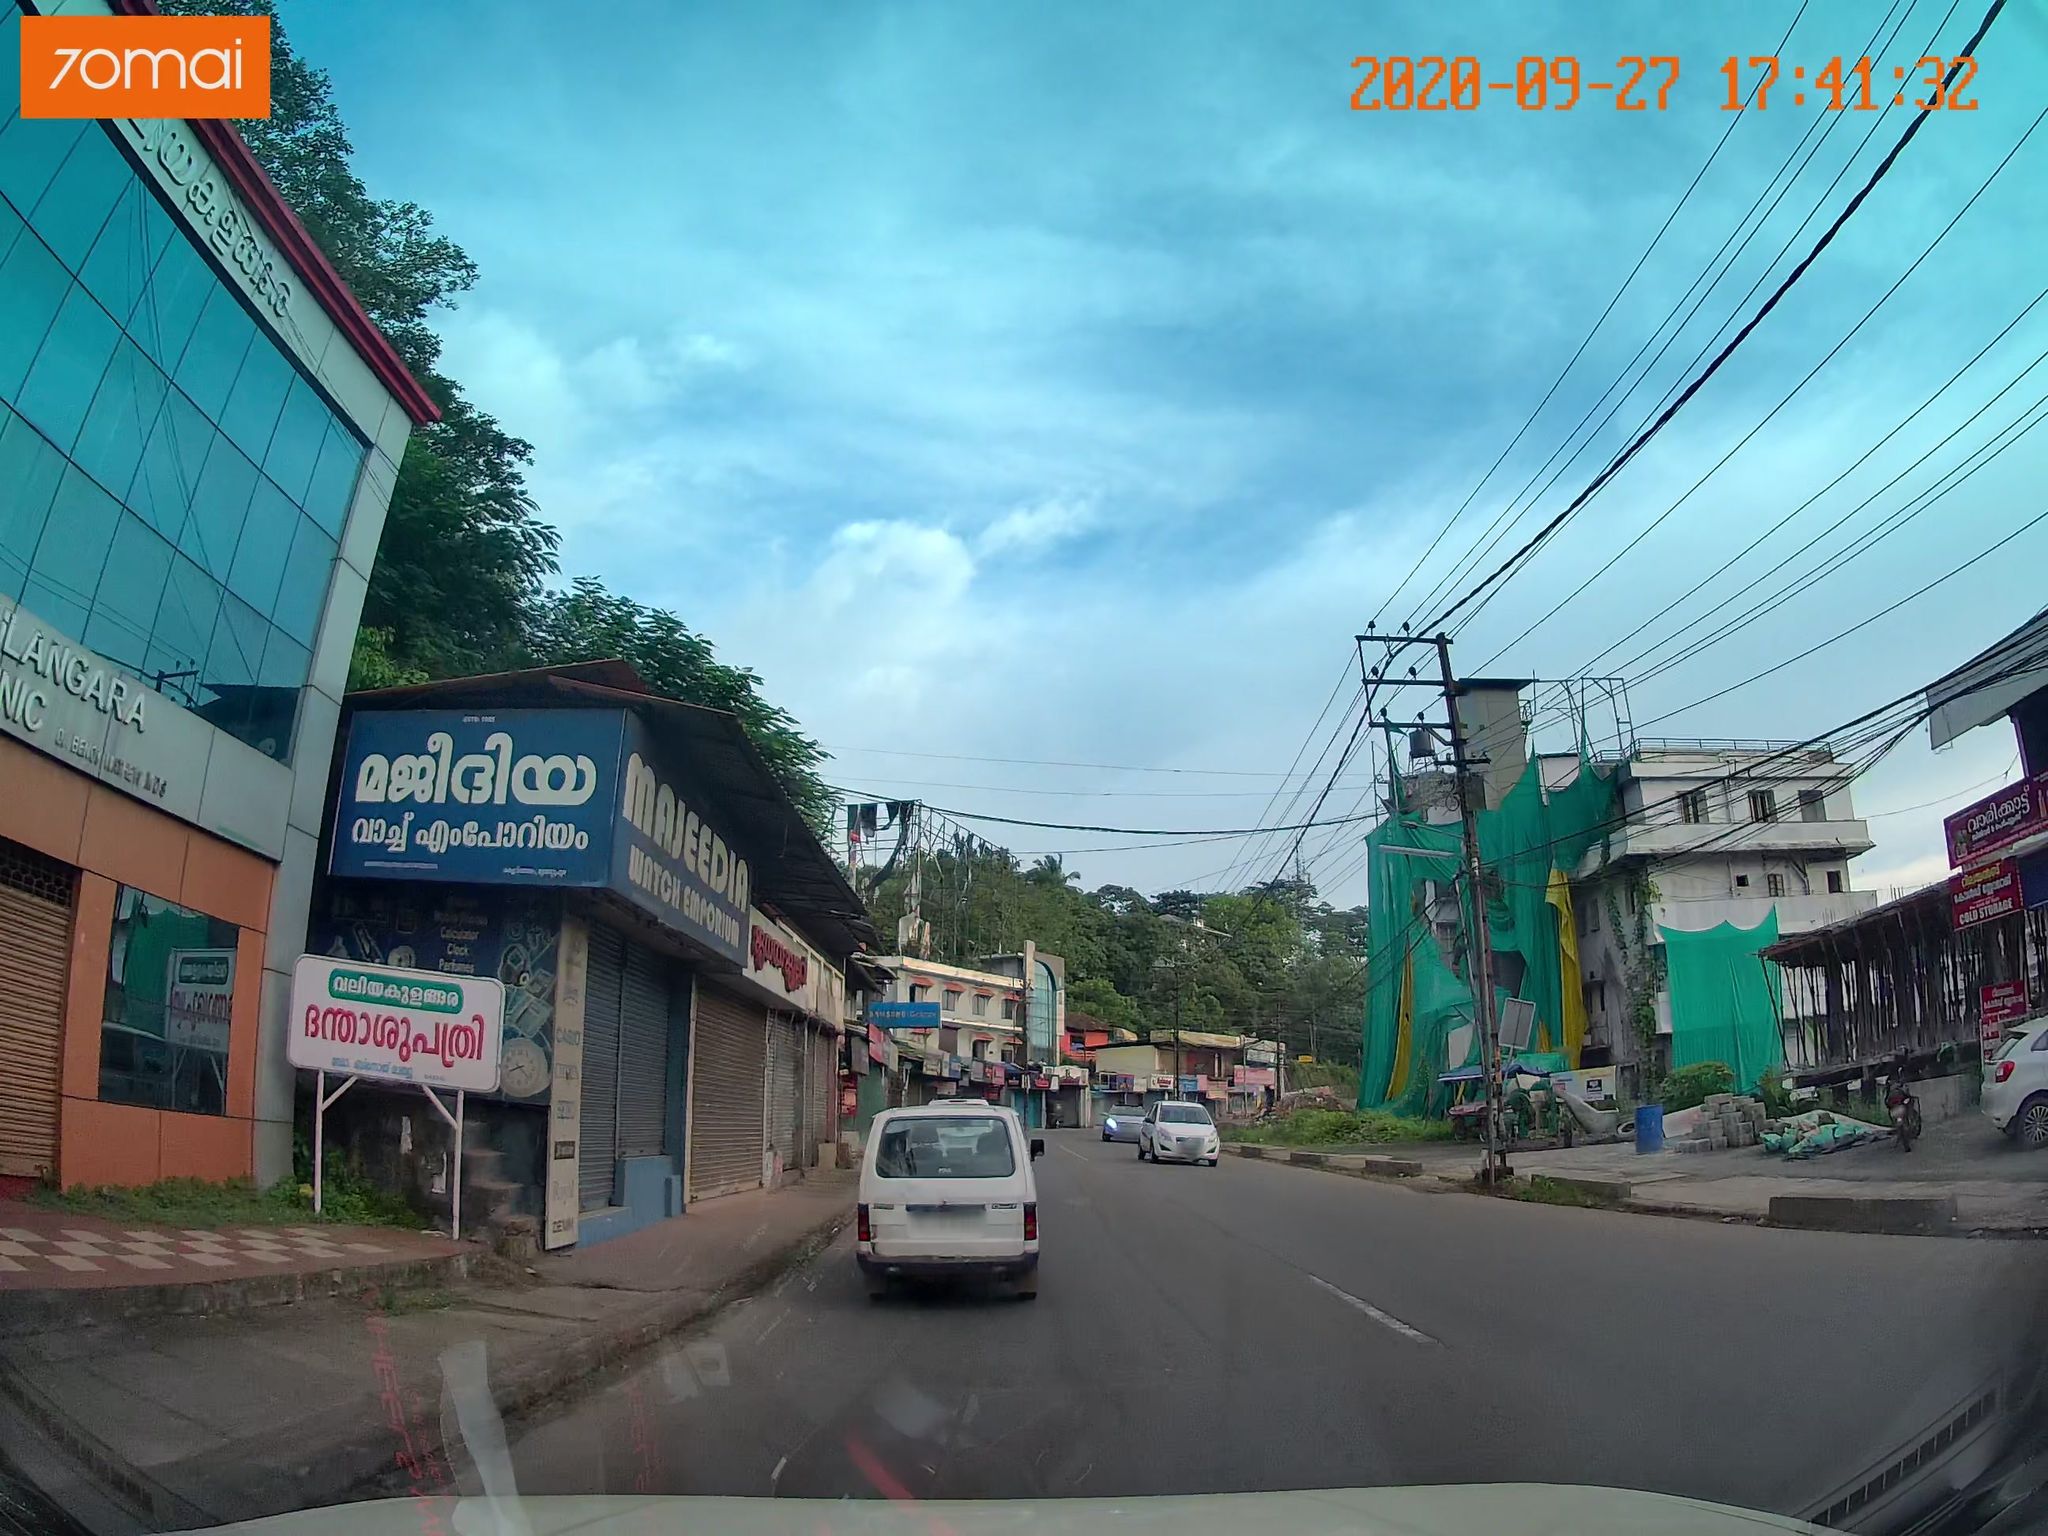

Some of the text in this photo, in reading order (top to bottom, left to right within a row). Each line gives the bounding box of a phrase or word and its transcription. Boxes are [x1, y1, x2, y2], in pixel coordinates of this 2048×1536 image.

[415, 814, 589, 854] എംപോറിയം
[622, 752, 750, 913] MAJEEDIA
[628, 844, 740, 948] WATCH EMPORIUM
[1959, 908, 1979, 925] COLD
[1979, 897, 2013, 919] STORAGE
[447, 943, 470, 956] Clock
[332, 975, 459, 1009] വലിയകുളങ്ങര
[304, 1003, 486, 1068] ദന്താശുപത്രി
